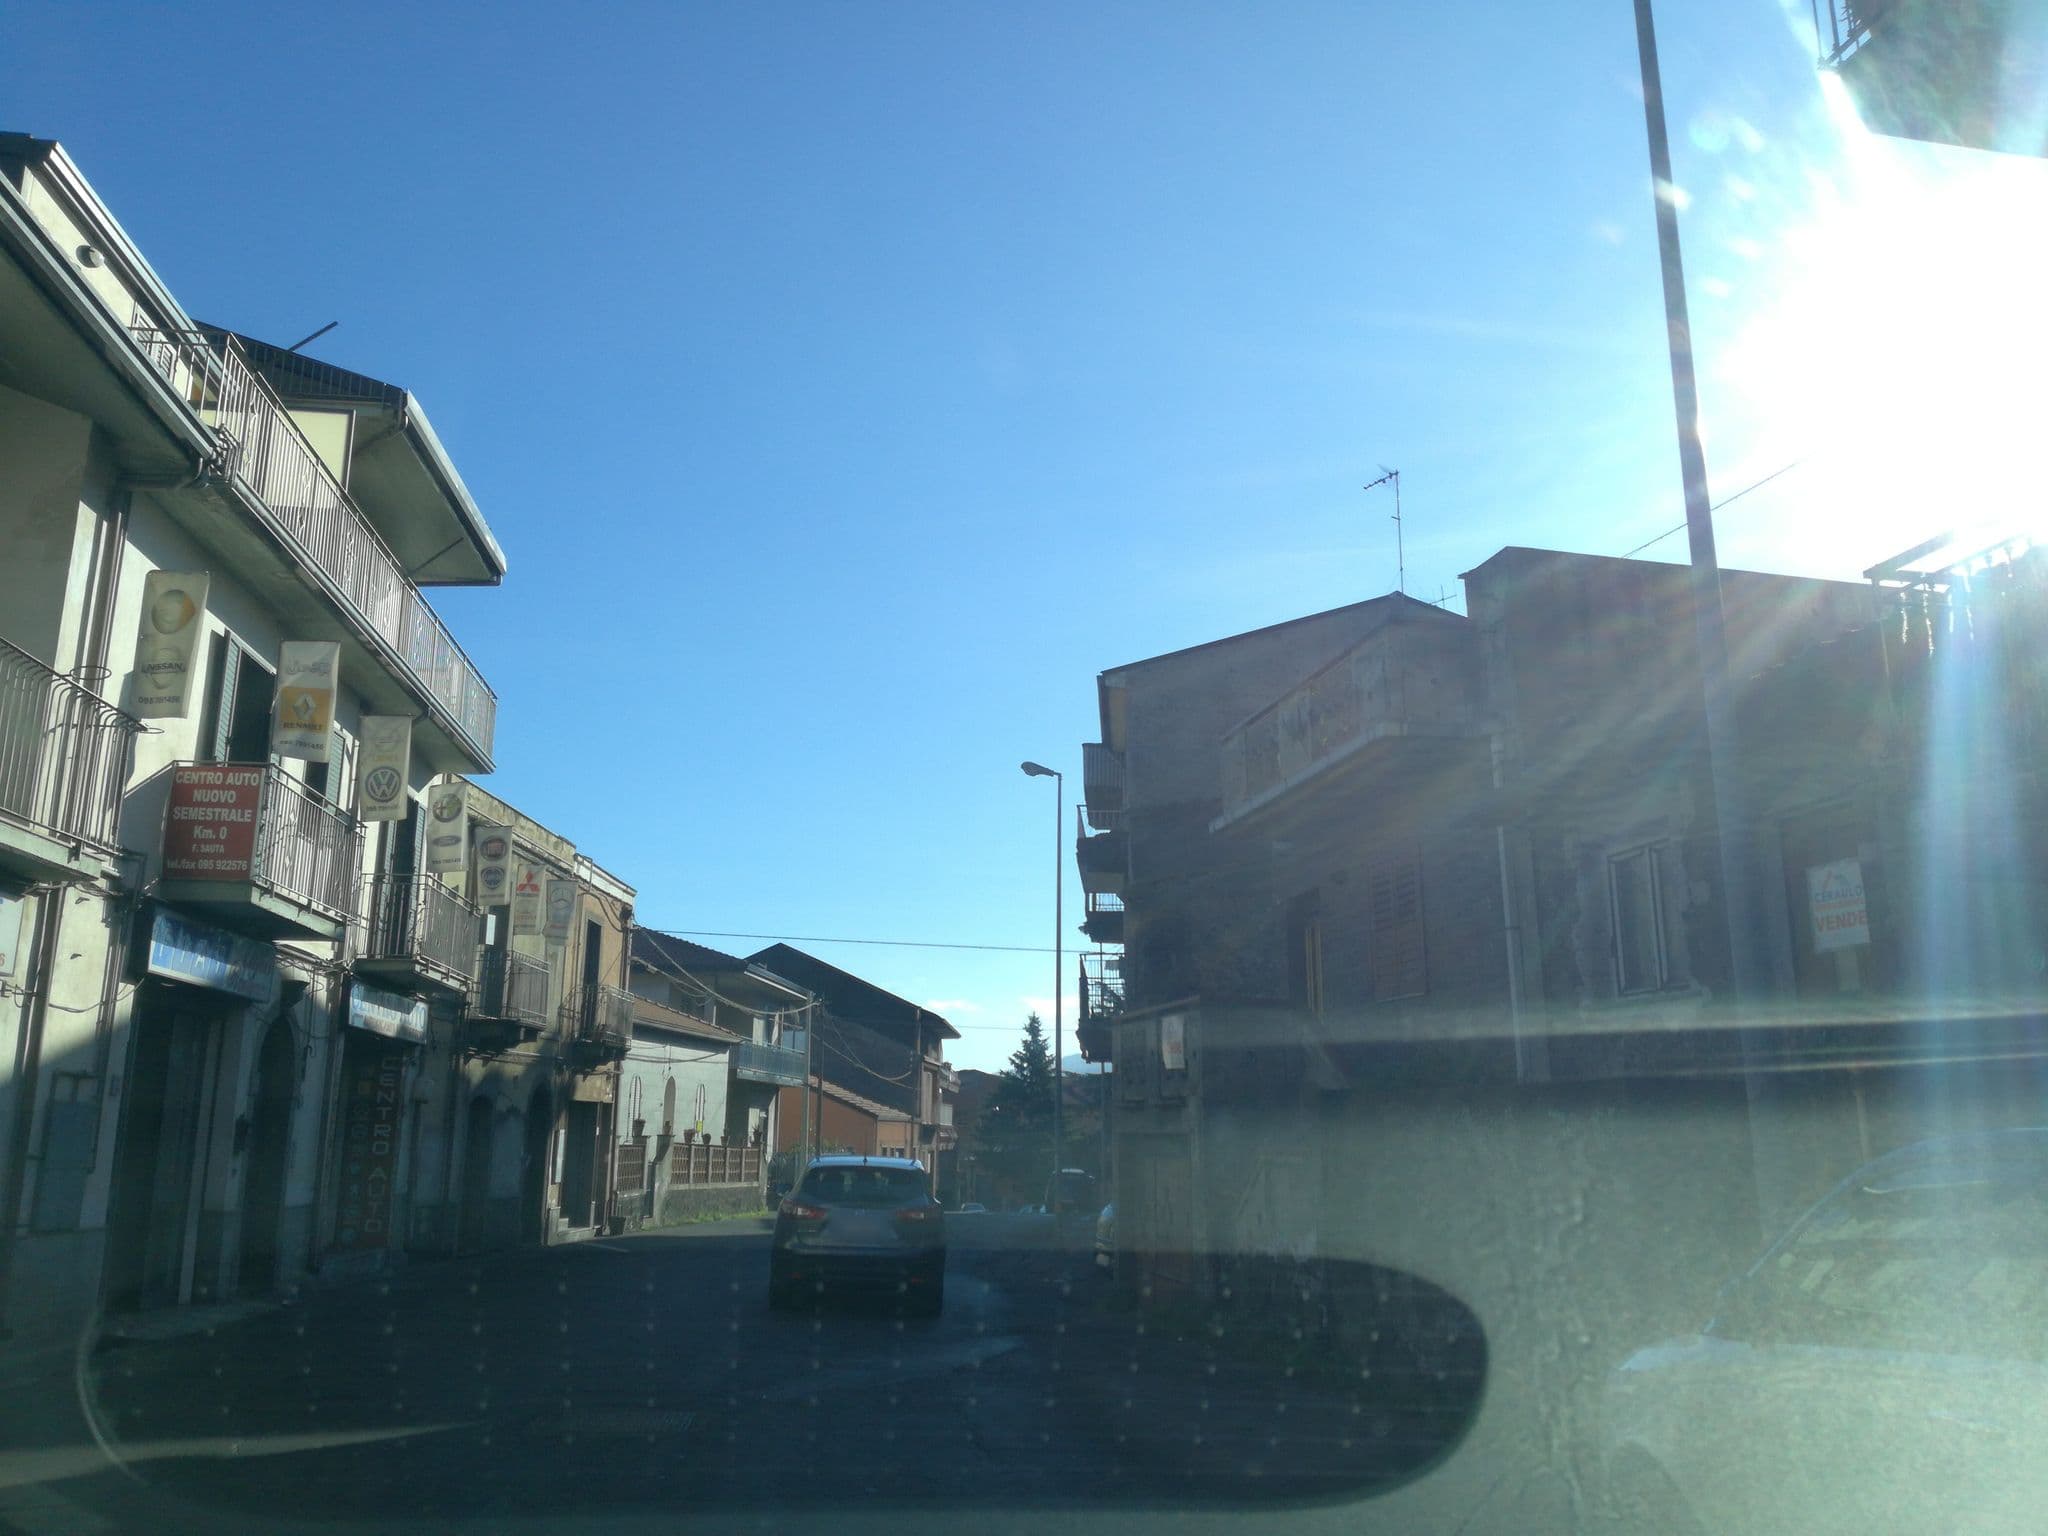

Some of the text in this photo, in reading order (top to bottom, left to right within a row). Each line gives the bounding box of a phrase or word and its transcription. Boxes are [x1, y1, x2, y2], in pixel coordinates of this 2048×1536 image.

[175, 771, 260, 786] CENTRO AUTO
[192, 789, 237, 803] NUOVO
[172, 806, 253, 822] SEMESTRALE
[193, 825, 228, 840] Km. 0
[198, 859, 214, 870] 095
[215, 859, 248, 871] 922576
[1815, 909, 1868, 932] VENDE
